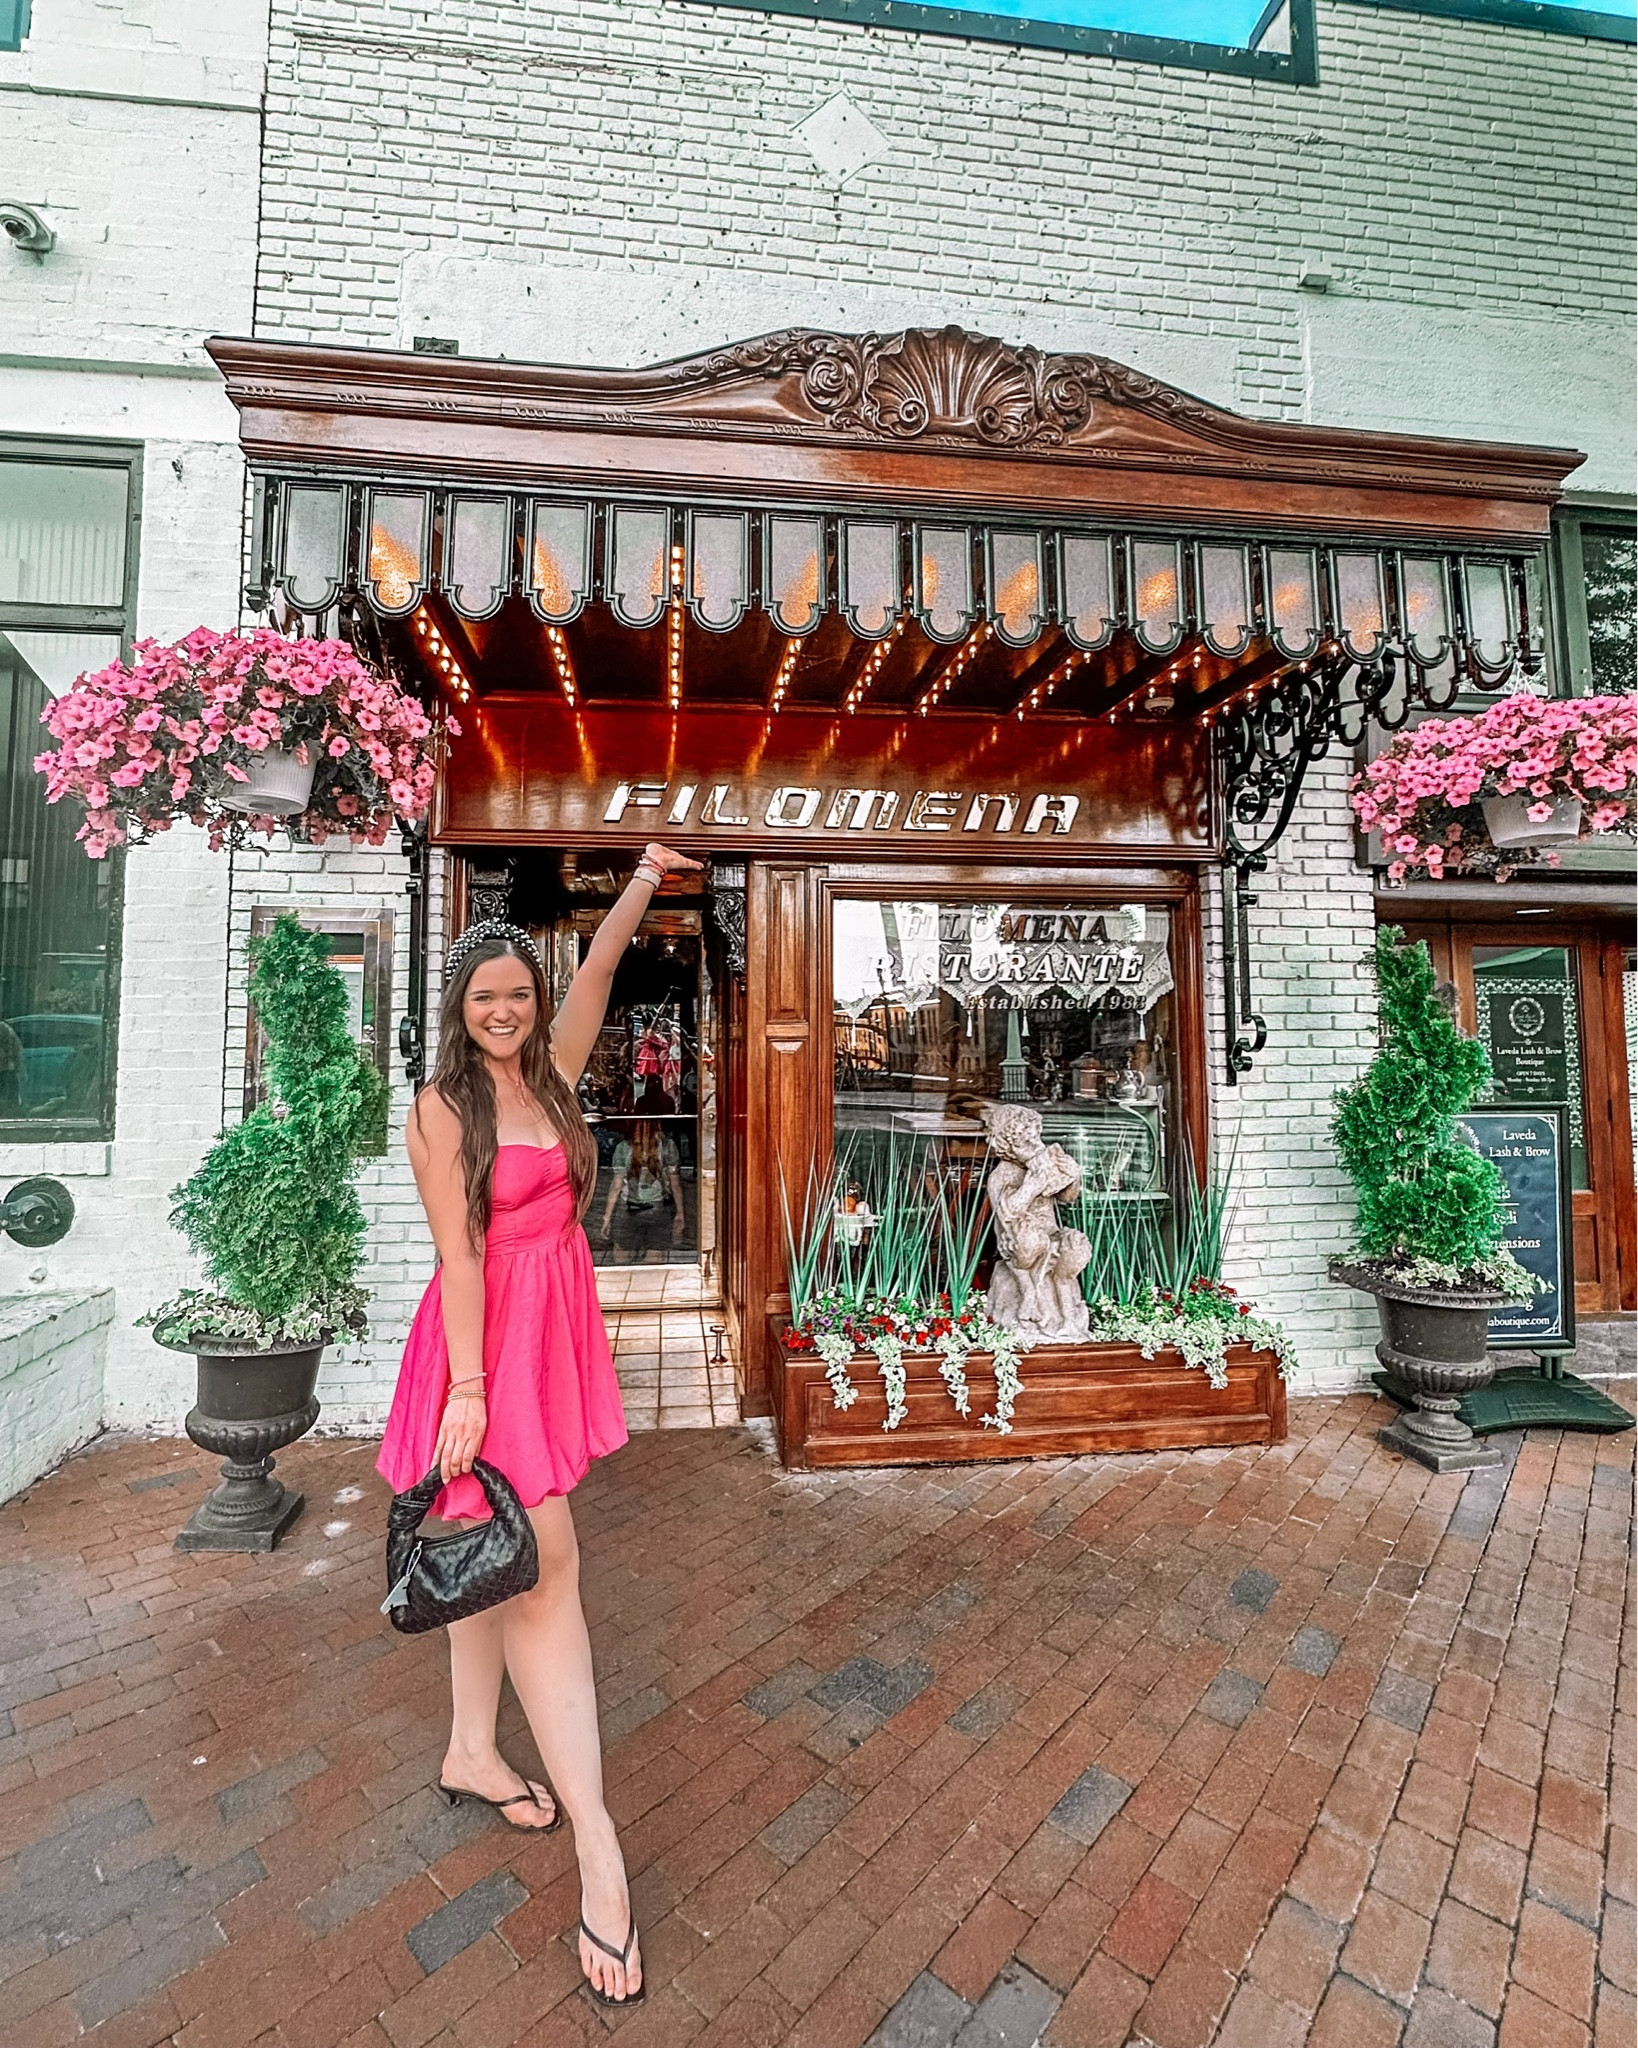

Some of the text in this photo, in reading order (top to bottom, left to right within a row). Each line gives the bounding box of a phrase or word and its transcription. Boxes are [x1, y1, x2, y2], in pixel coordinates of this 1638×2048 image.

[602, 780, 1081, 834] FILOMENA
[899, 913, 1110, 942] FILOMENA
[863, 952, 1144, 983] RISTORANTE
[963, 994, 1091, 1010] Established
[1496, 1046, 1563, 1055] Laveda Lash & Brow
[1515, 1057, 1545, 1067] Boutique
[1503, 1128, 1537, 1140] Laveda
[1489, 1145, 1551, 1157] Lash & Brow
